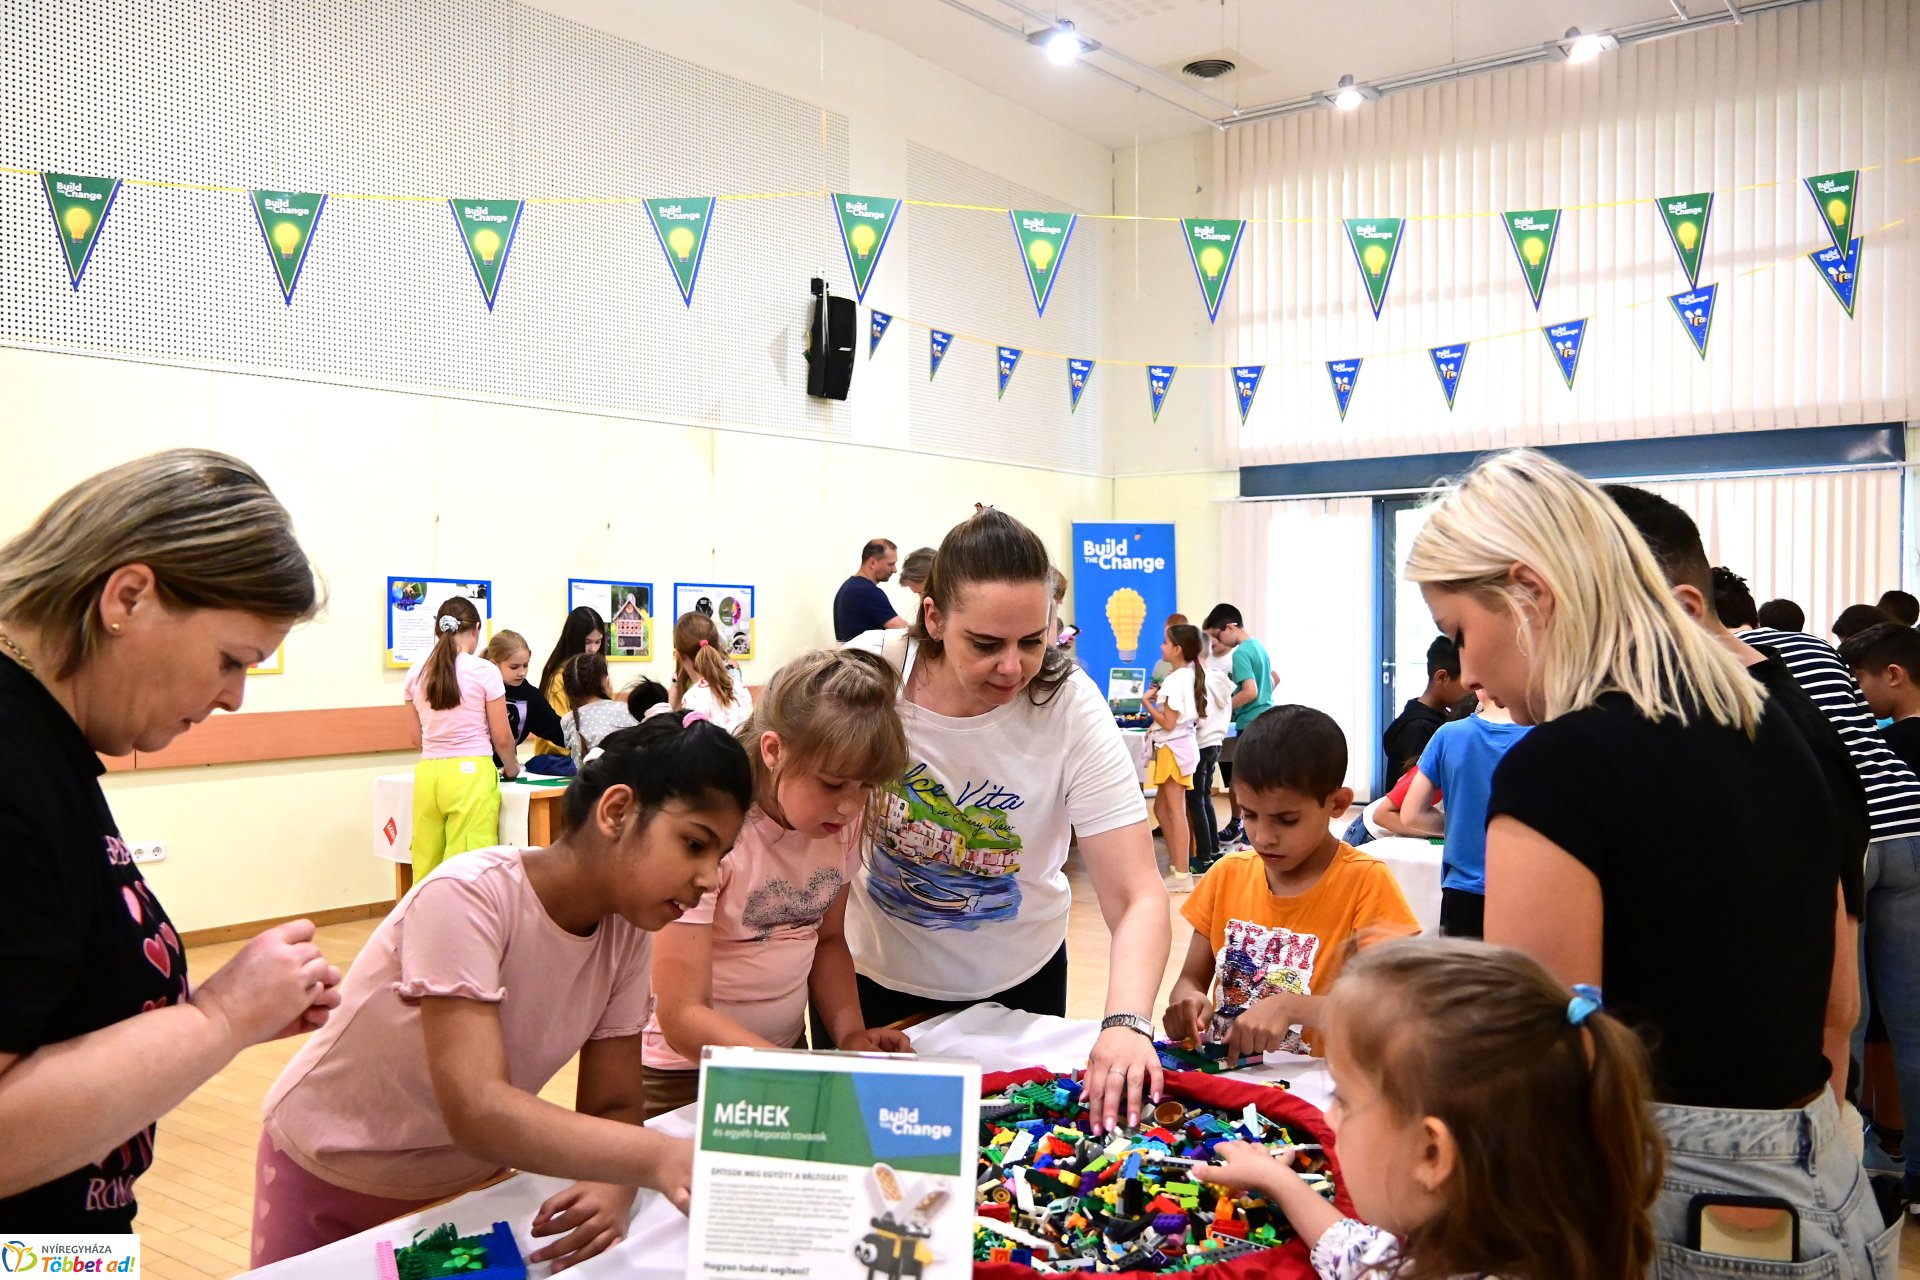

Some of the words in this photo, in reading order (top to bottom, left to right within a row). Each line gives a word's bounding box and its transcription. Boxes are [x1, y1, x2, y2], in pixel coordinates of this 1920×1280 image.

[56, 182, 82, 192] Build
[1817, 180, 1834, 188] Build
[1823, 185, 1850, 194] Change
[64, 189, 102, 201] Change
[264, 198, 290, 208] Build
[846, 202, 868, 211] Build
[1668, 202, 1687, 210] Build
[272, 206, 310, 216] Change
[464, 206, 488, 215] Build
[659, 205, 682, 214] Build
[1674, 207, 1702, 215] Change
[472, 214, 508, 223] Change
[666, 212, 700, 221] Change
[852, 210, 885, 220] Change
[1023, 218, 1044, 227] Build
[1514, 217, 1534, 226] Build
[1030, 226, 1062, 234] Change
[1194, 226, 1214, 234] Build
[1356, 225, 1376, 233] Build
[1200, 234, 1231, 242] Change
[1364, 232, 1392, 240] Change
[1083, 538, 1128, 557] Build
[1084, 556, 1098, 564] THE
[1098, 555, 1165, 574] Change
[902, 762, 948, 797] lce
[955, 779, 1025, 810] Vita
[1227, 920, 1317, 970] TEAM
[714, 1100, 790, 1128] MÉHEK
[879, 1106, 918, 1124] Build
[892, 1122, 952, 1140] Change
